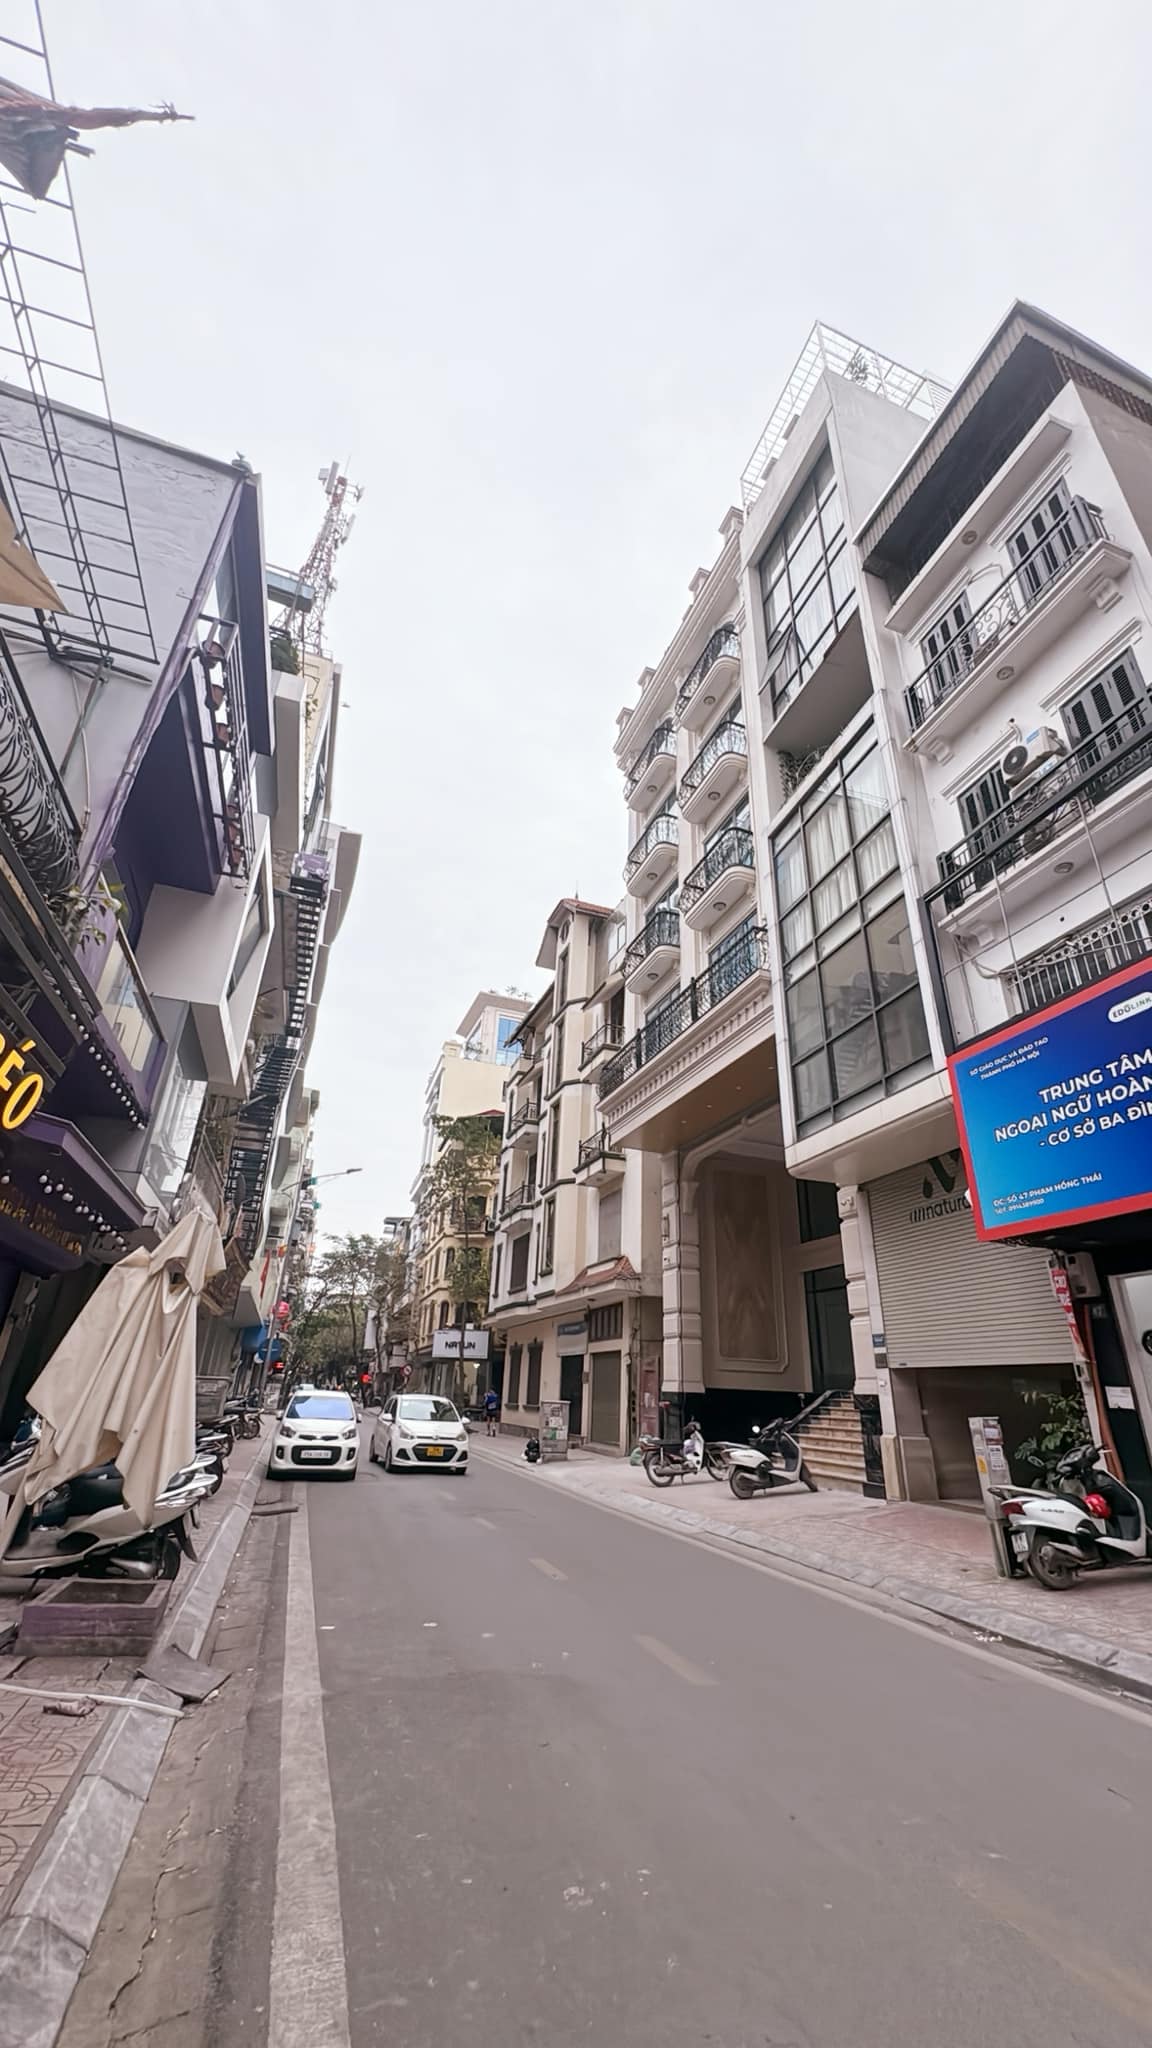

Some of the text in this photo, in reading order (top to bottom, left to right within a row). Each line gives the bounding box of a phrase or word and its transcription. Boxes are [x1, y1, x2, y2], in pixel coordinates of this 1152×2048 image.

[978, 1061, 994, 1072] GIÁO
[1008, 1049, 1018, 1059] VÀ
[1039, 1047, 1152, 1104] TRUNG TÂM
[994, 1112, 1048, 1143] NGOẠI
[1051, 1093, 1092, 1123] NGỮ
[1048, 1127, 1071, 1146] CƠ
[1073, 1117, 1096, 1138] SỞ
[1098, 1112, 1125, 1130] BA
[1080, 1171, 1103, 1185] THÁI
